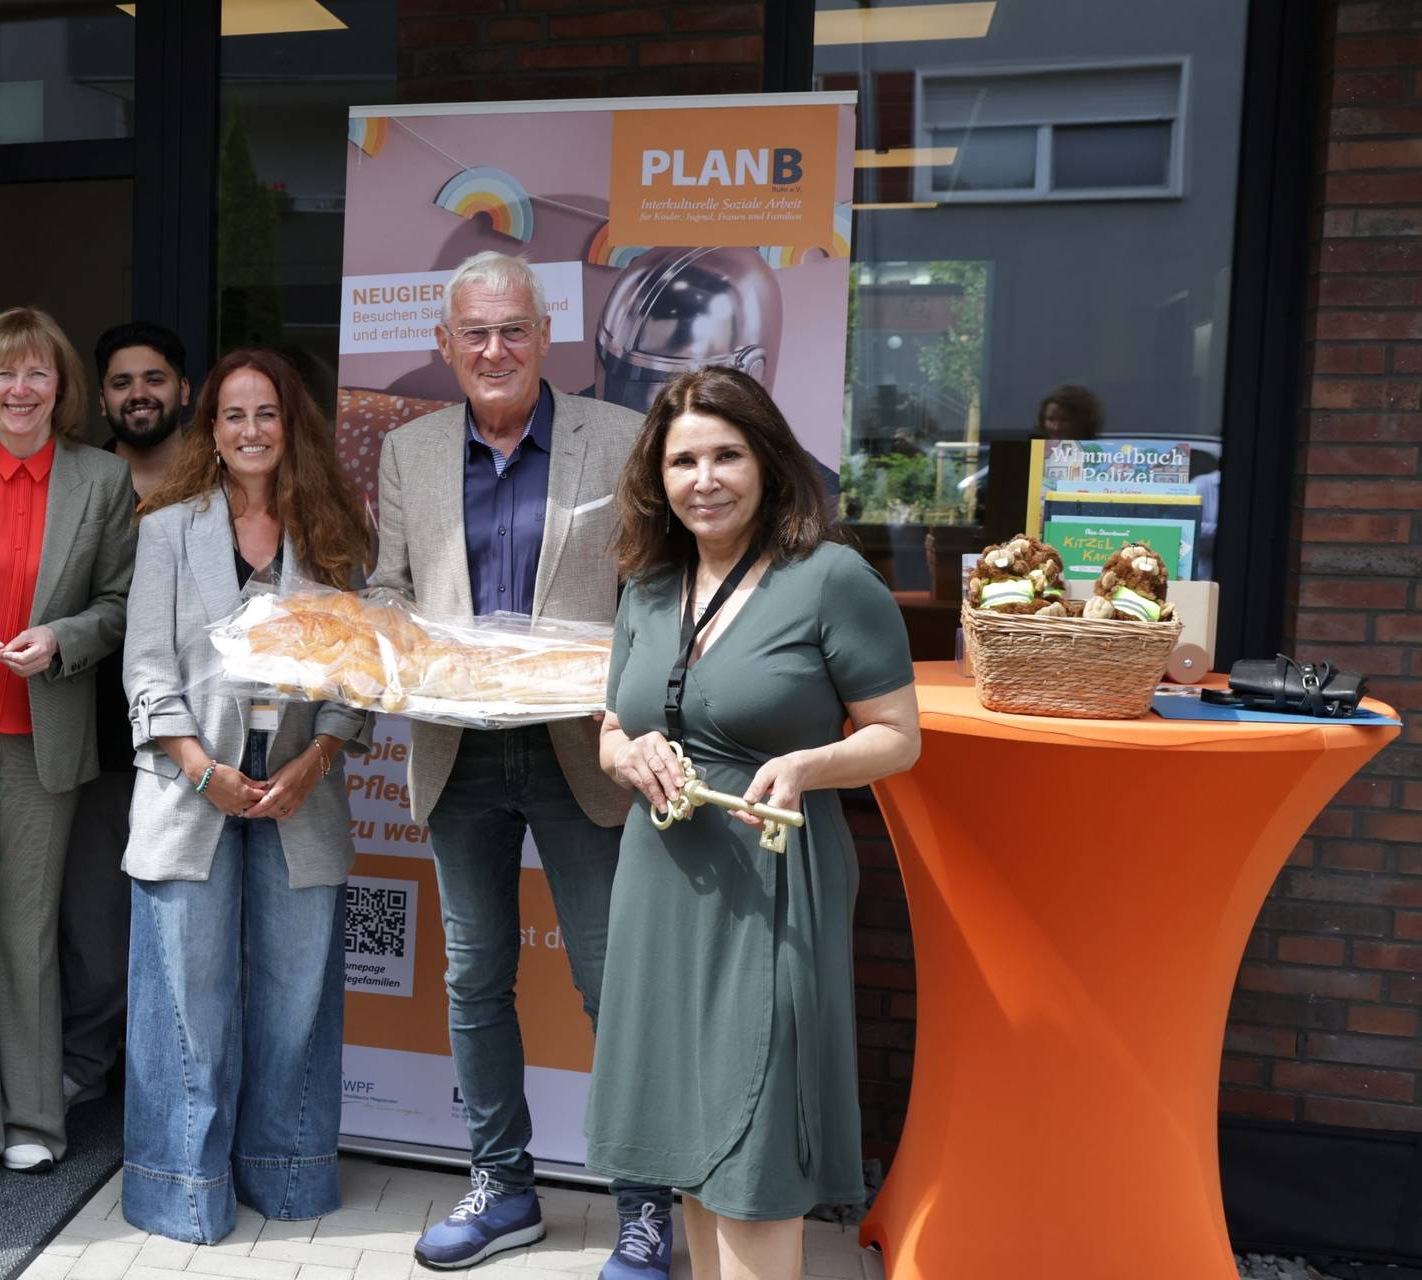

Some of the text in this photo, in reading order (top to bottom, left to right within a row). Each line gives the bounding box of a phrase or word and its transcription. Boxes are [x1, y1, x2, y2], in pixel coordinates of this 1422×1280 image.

[641, 148, 803, 186] PLANB
[641, 197, 802, 210] Interkulturelle Soziale Arbeit
[352, 307, 418, 324] Besuchen
[421, 306, 443, 320] Sie
[352, 327, 377, 342] und
[1051, 446, 1184, 466] Wimmelbuch
[1081, 466, 1155, 483] Polizei
